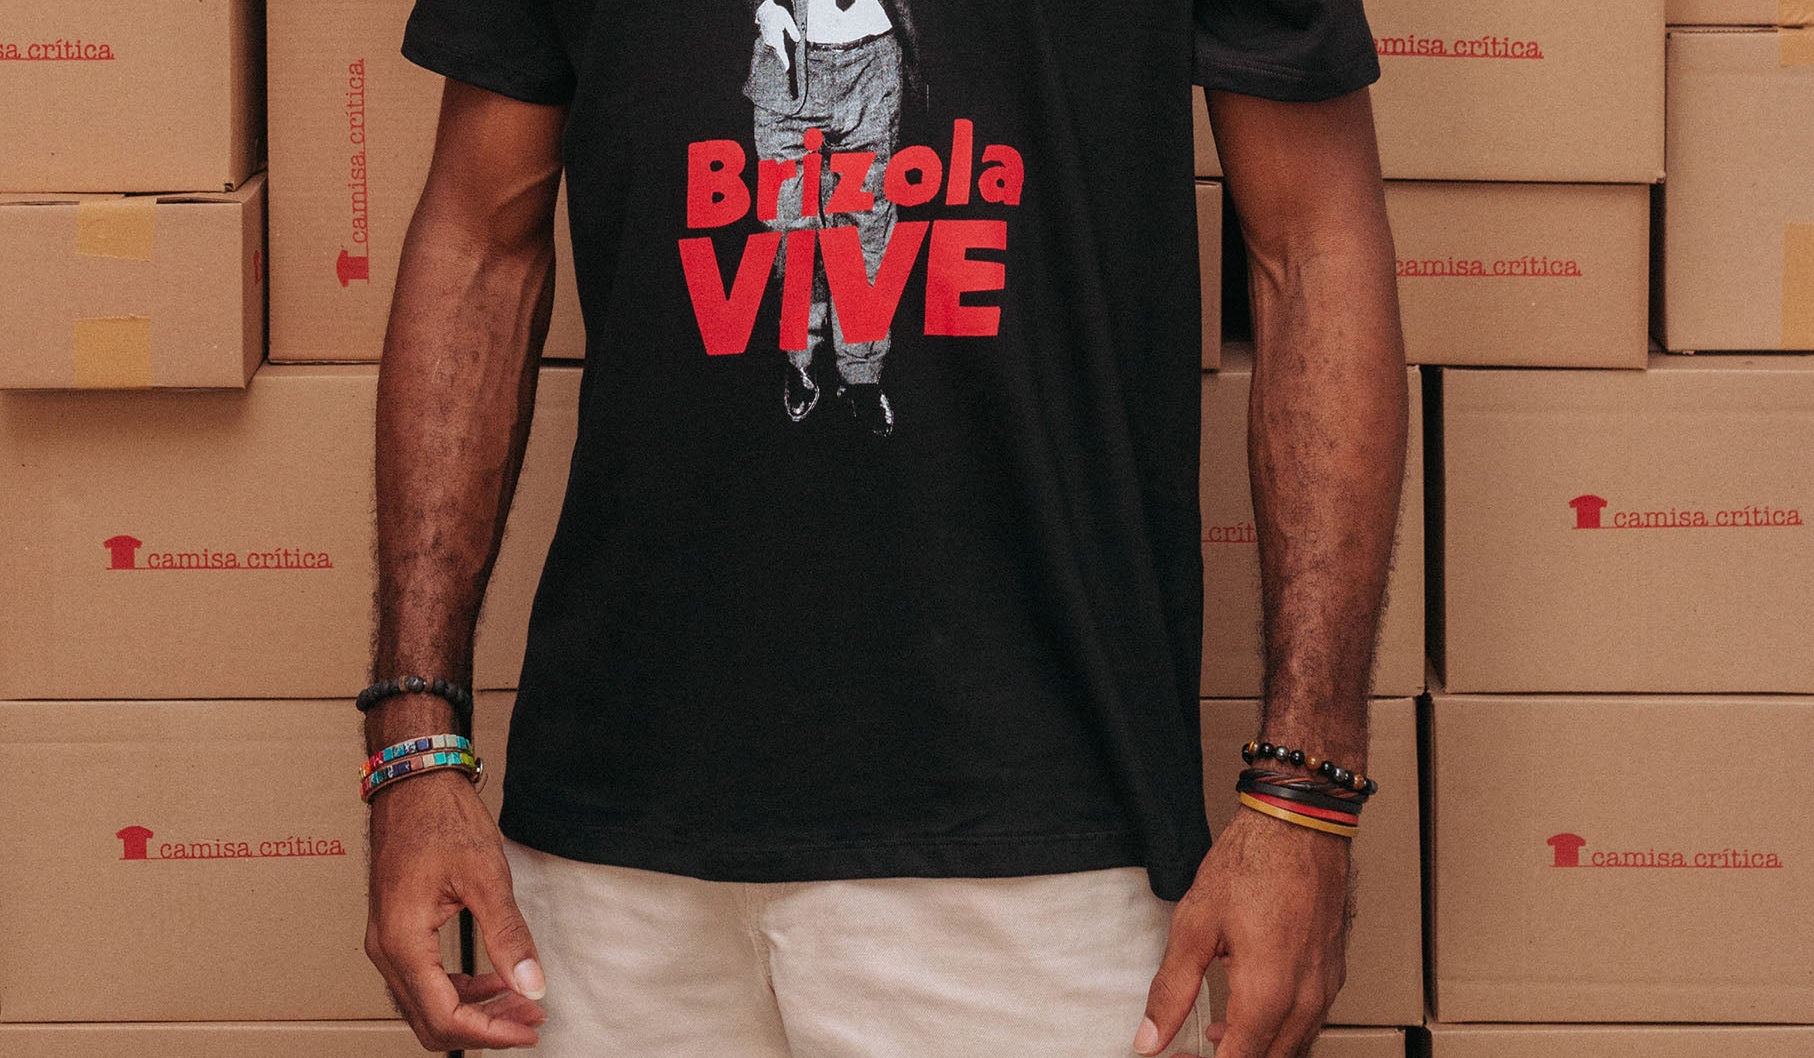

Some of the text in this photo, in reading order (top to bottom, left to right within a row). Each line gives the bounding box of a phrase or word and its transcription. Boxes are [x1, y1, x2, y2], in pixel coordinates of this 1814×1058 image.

[27, 38, 116, 61] crítica
[1454, 35, 1544, 60] crítica
[345, 58, 367, 244] camisa crítica
[686, 118, 1025, 229] Brizola
[1493, 255, 1582, 277] crítica
[678, 219, 1007, 356] VIVE
[1613, 505, 1804, 529] camisa crítica
[1208, 522, 1257, 544] crít
[148, 547, 334, 570] camisa crítica
[160, 836, 347, 859] camisa crítica
[1592, 848, 1784, 869] camisa crítica
